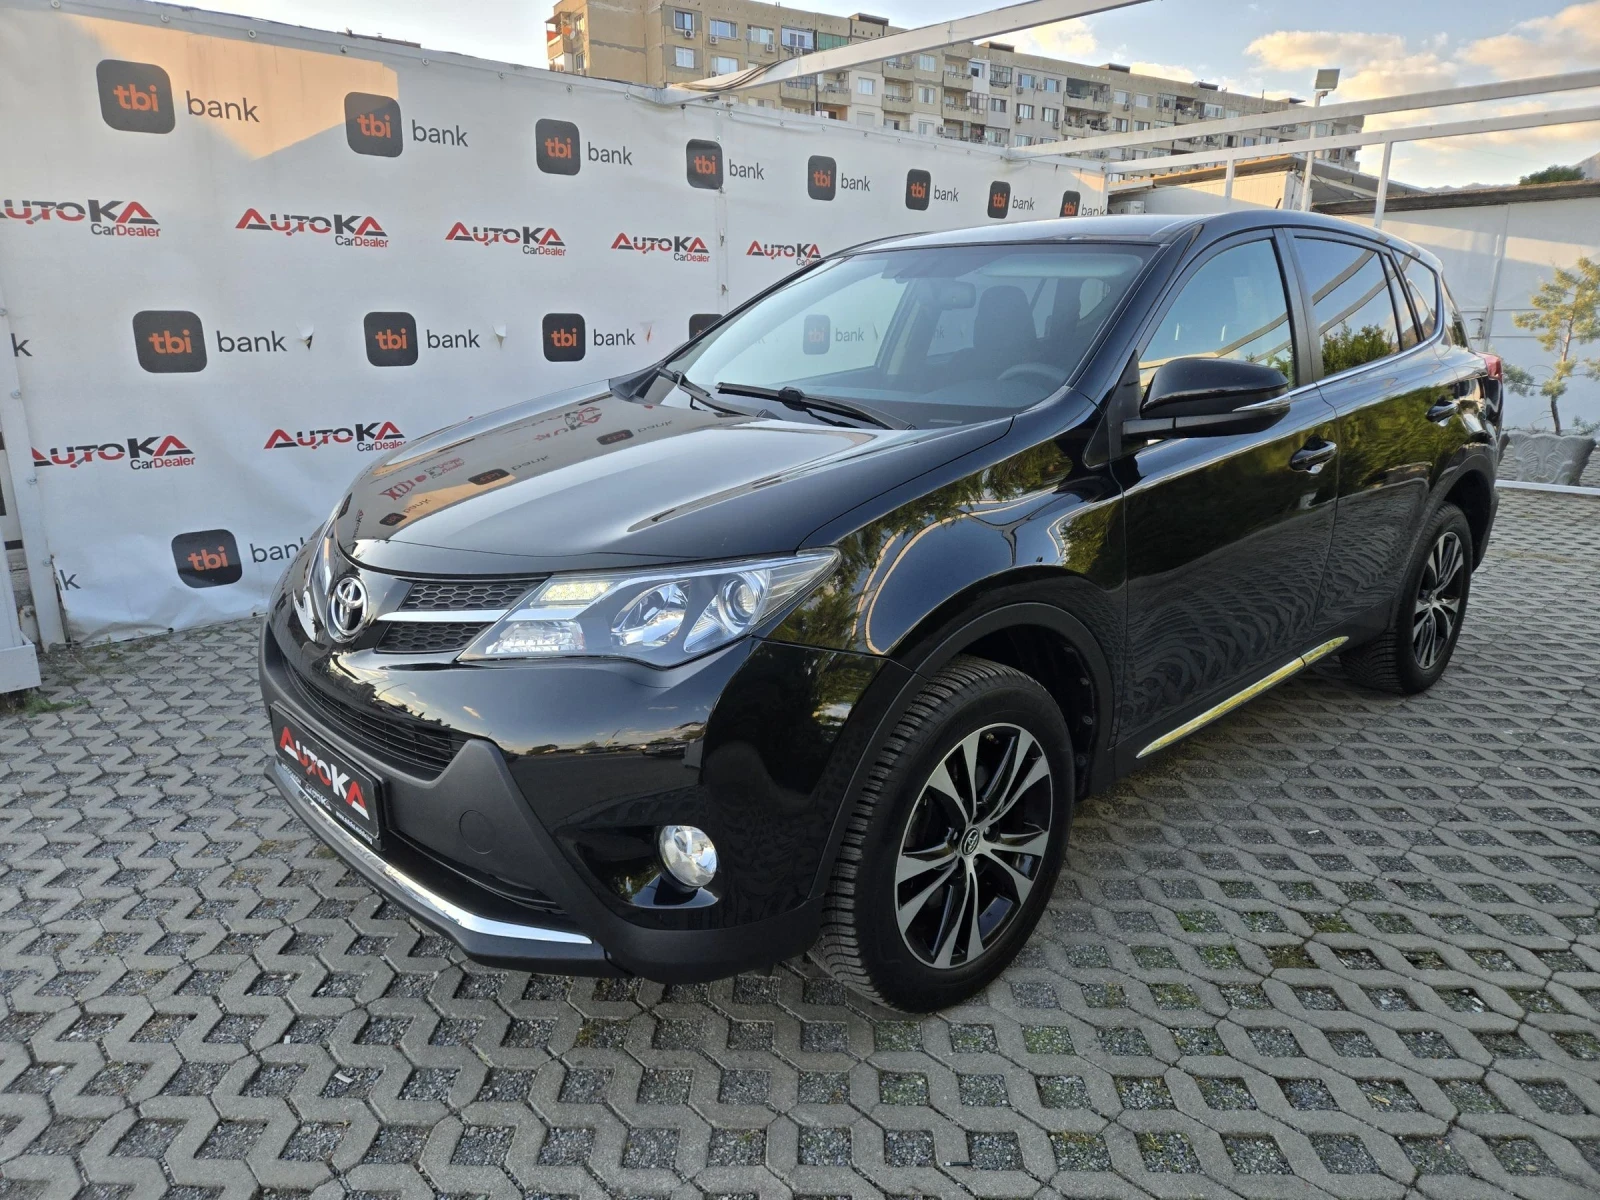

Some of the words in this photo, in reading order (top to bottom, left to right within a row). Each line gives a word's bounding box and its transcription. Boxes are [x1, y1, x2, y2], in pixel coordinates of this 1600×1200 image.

[113, 83, 159, 112] tbi
[186, 90, 260, 123] bank
[357, 114, 391, 139] tbi
[411, 120, 468, 148] bank
[545, 137, 572, 160] tbi
[588, 142, 632, 166] bank
[694, 155, 716, 174] tbi
[729, 159, 764, 180] bank
[812, 171, 831, 188] tbi
[841, 174, 871, 192] bank
[910, 181, 926, 198] tbi
[934, 185, 959, 203] bank
[992, 192, 1007, 209] tbi
[1012, 195, 1035, 211] bank
[1081, 204, 1106, 216] bank
[91, 223, 161, 237] CarDealer
[335, 235, 389, 248] CarDealer
[522, 245, 566, 256] CarDealer
[674, 253, 710, 262] CarDealer
[149, 329, 192, 354] tbi
[216, 330, 287, 353] bank
[375, 328, 407, 350] tbi
[427, 329, 480, 349] bank
[551, 329, 577, 348] tbi
[593, 329, 635, 347] bank
[835, 327, 864, 342] bank
[357, 440, 407, 452] CarDeale
[130, 457, 196, 470] CarDealer
[188, 546, 228, 571] tbi
